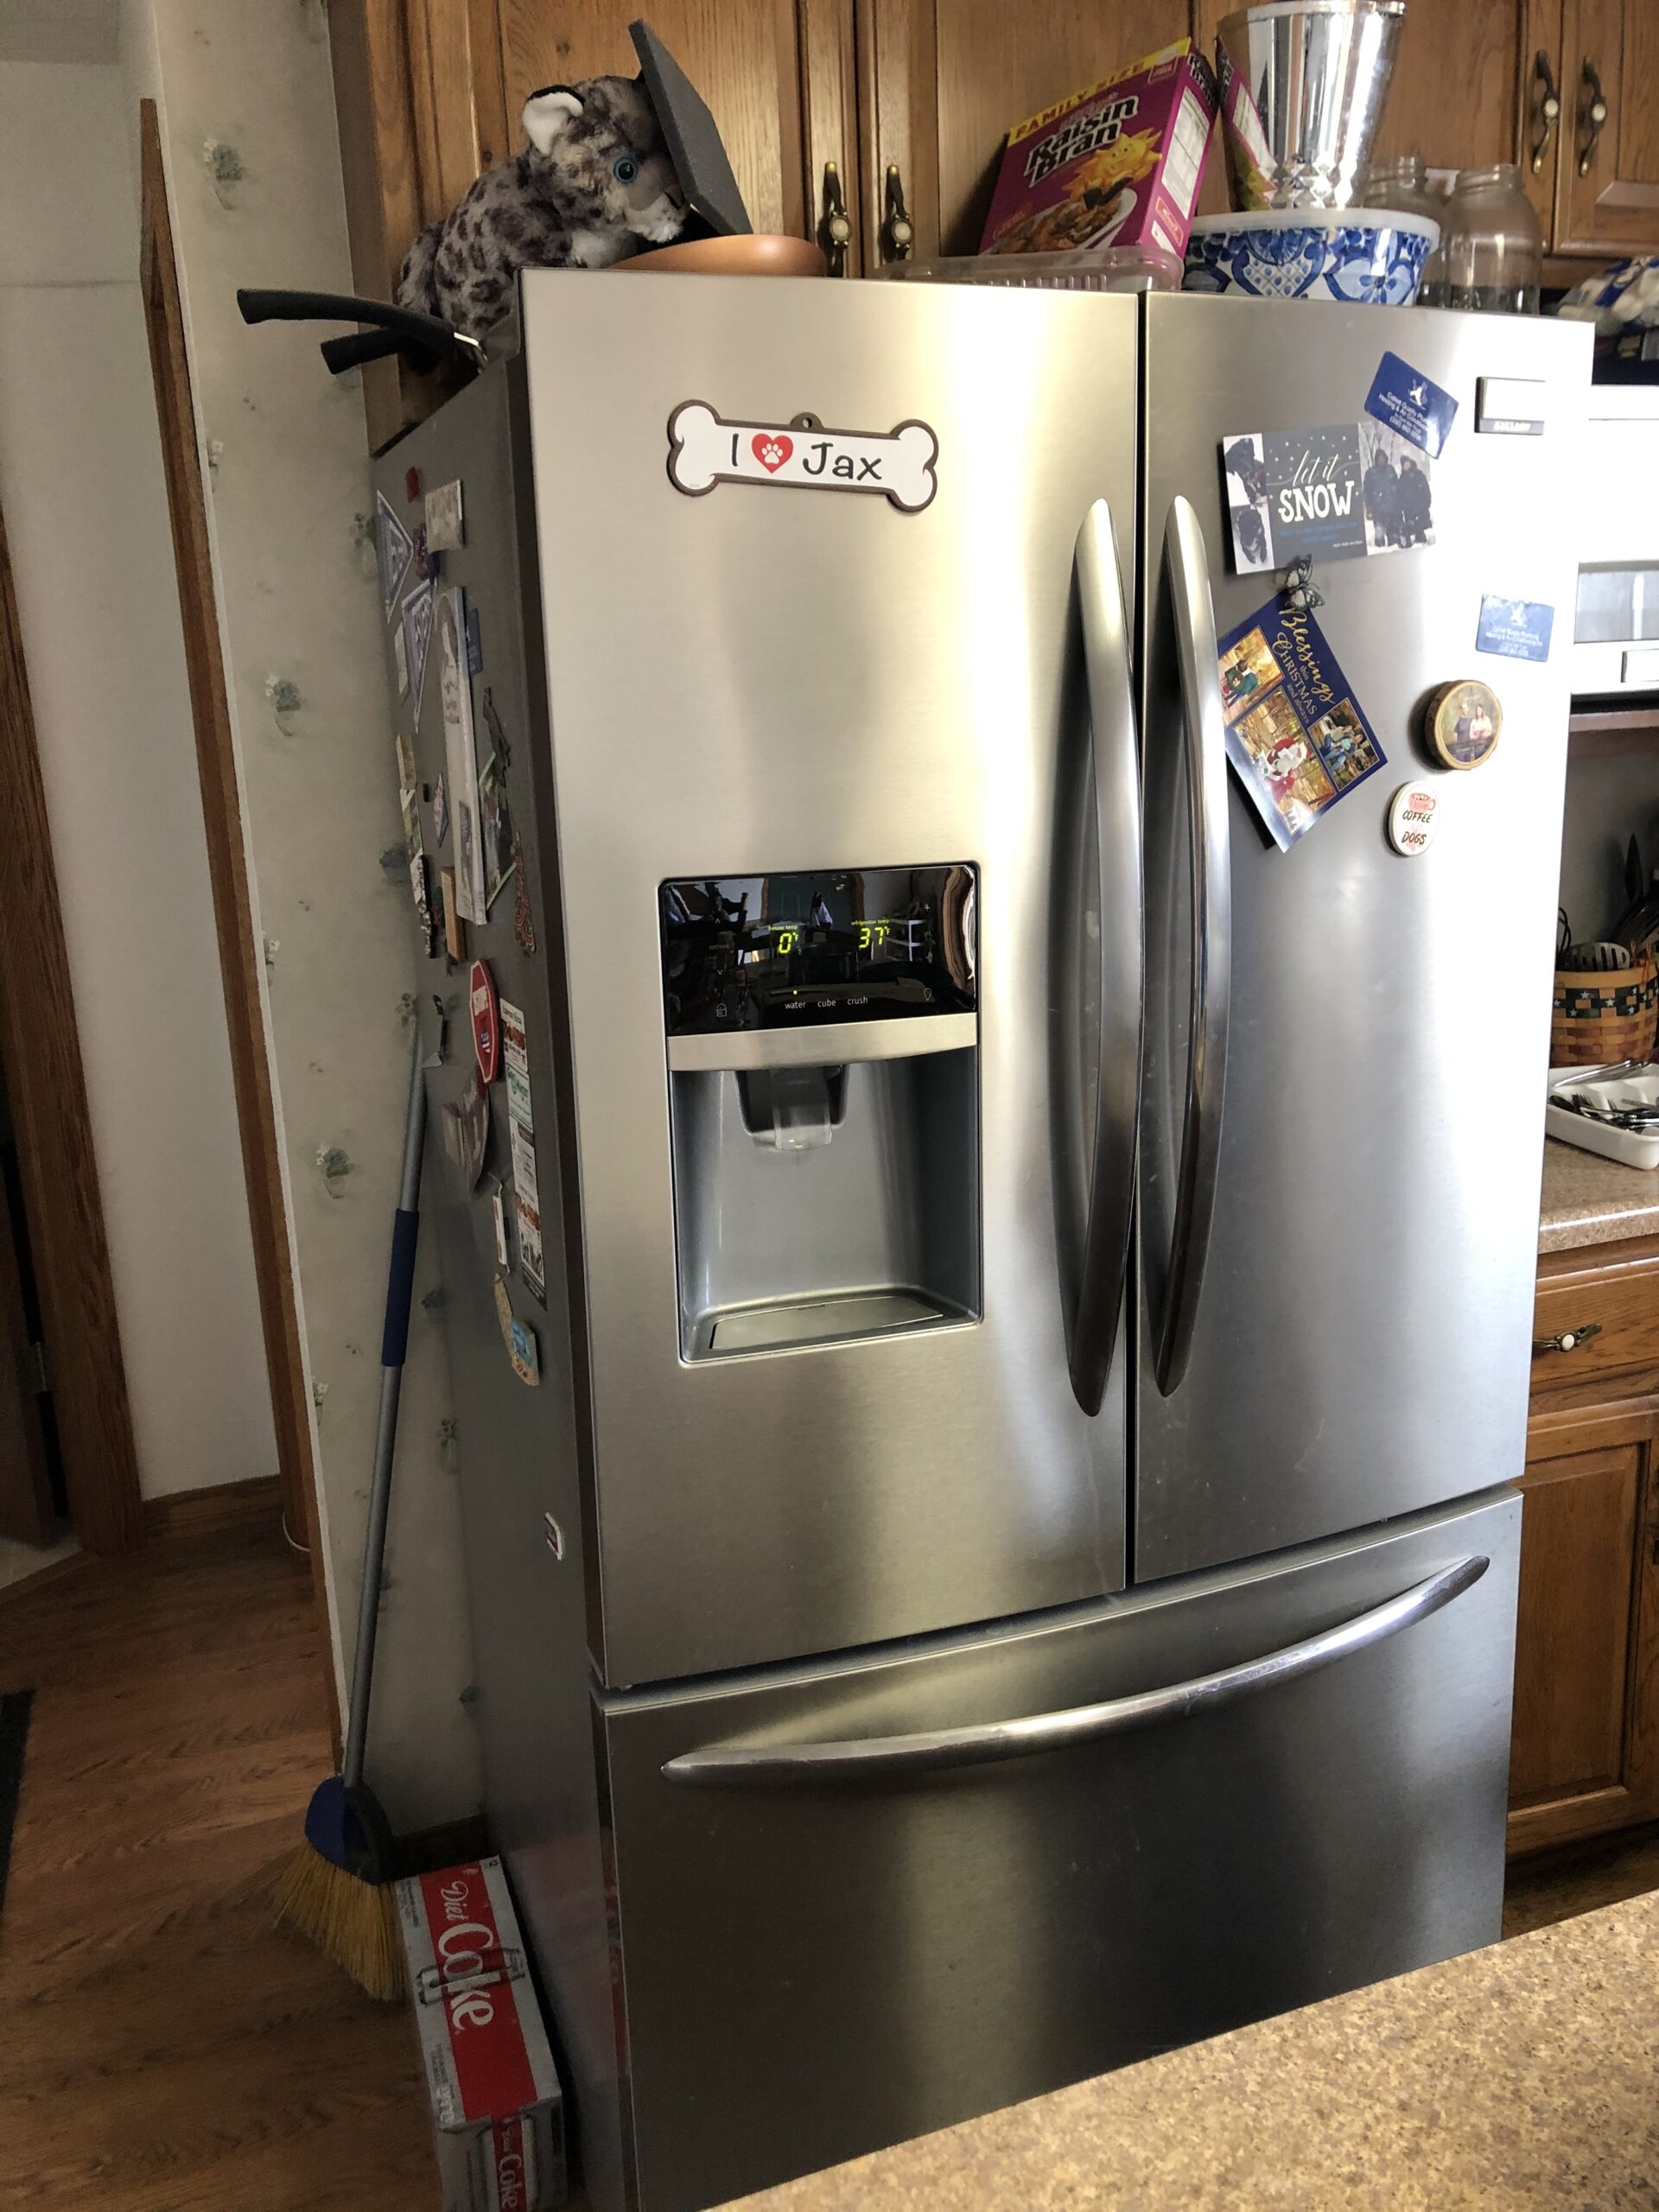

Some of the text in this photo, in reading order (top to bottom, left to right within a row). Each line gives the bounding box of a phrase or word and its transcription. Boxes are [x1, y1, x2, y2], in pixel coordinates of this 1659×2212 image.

[1023, 95, 1140, 177] Raisin
[1029, 120, 1122, 188] Bran
[731, 432, 883, 481] I Jax
[1293, 449, 1340, 487] let it
[1278, 480, 1355, 524] SNOW
[1279, 607, 1336, 704] Blessings
[1300, 664, 1310, 681] this
[1401, 830, 1427, 845] DOGS
[1402, 809, 1433, 823] COFFEE
[785, 995, 868, 1010] water cube crush
[436, 1880, 495, 2031] Diet Coke
[499, 2153, 524, 2209] Coke
